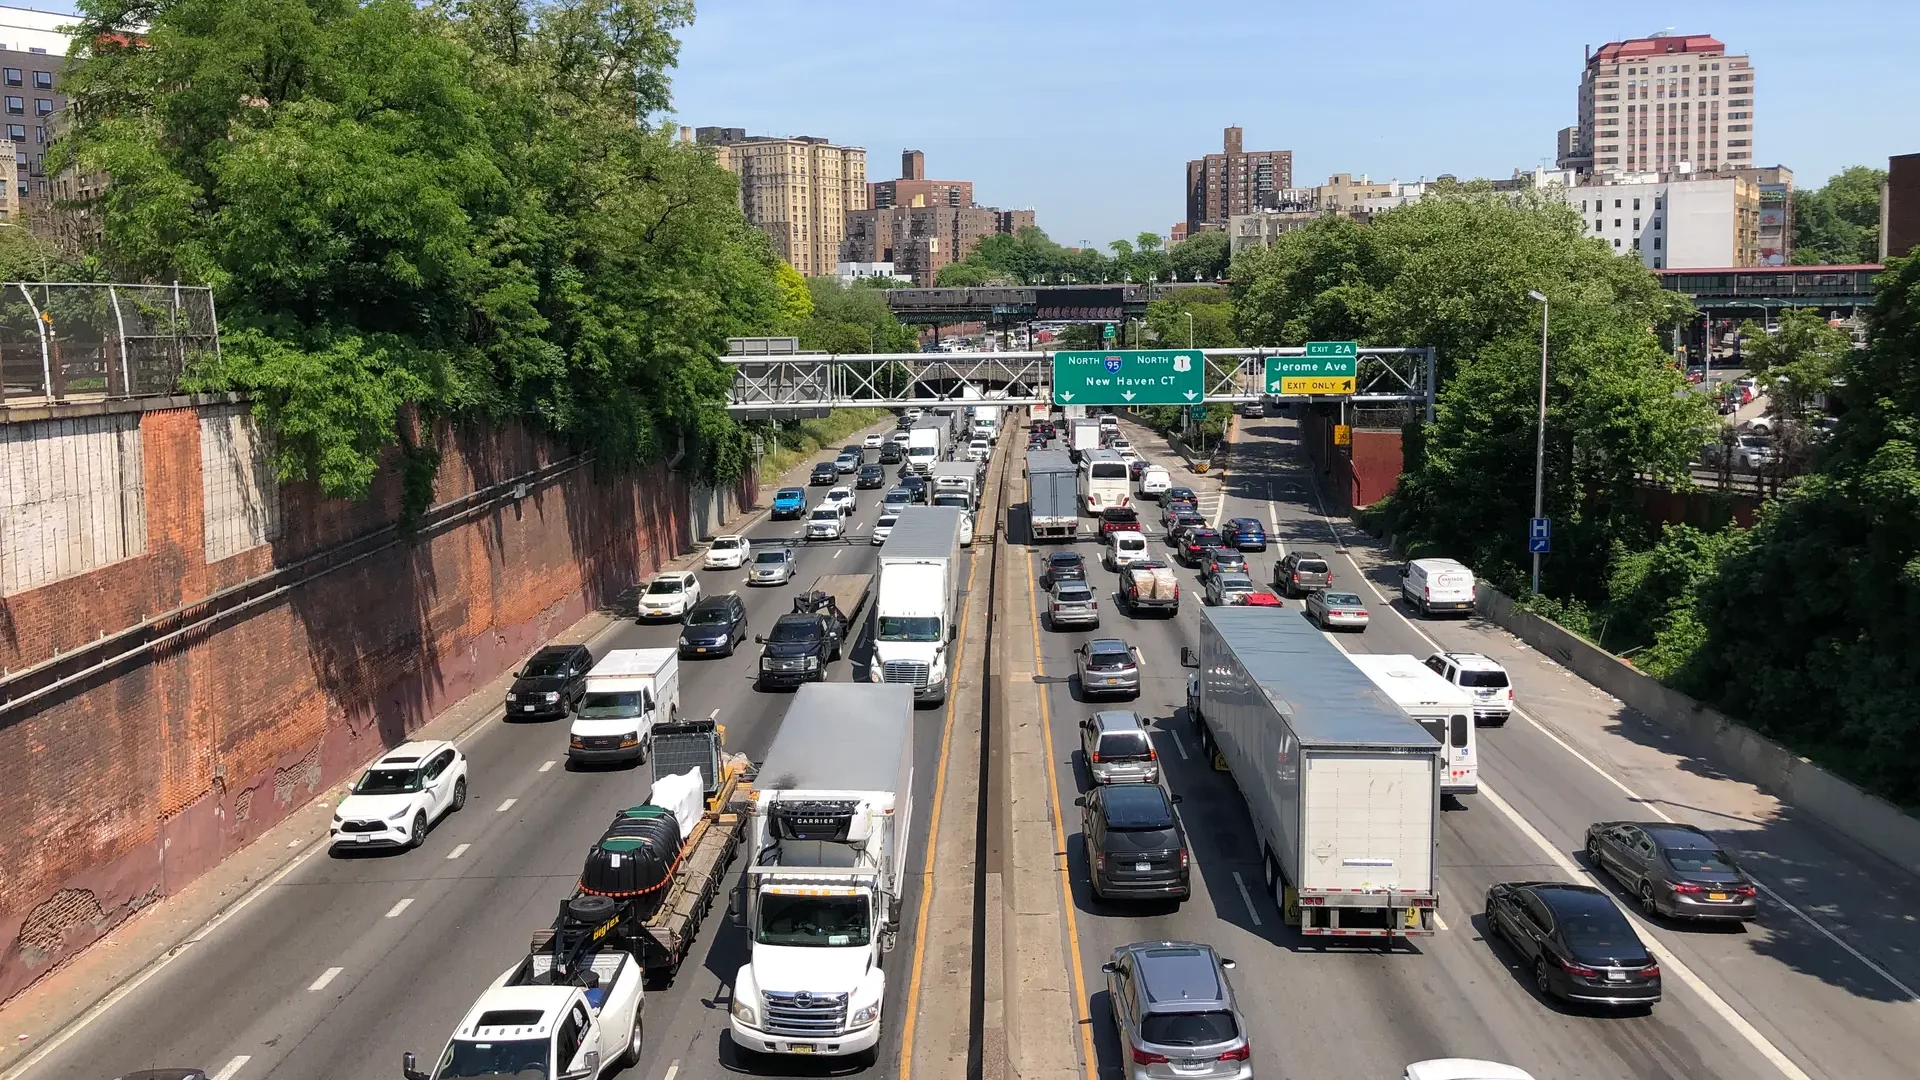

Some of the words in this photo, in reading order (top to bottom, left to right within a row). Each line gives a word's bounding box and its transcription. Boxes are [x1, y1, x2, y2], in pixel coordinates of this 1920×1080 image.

[1334, 345, 1351, 354] 2A
[1068, 356, 1100, 365] NORTH
[1107, 361, 1119, 370] 95
[1137, 355, 1169, 364] NORTH
[1274, 362, 1318, 371] Jerome
[1324, 361, 1347, 371] Ave
[1086, 377, 1110, 386] New
[1117, 376, 1155, 386] Haven
[1161, 376, 1175, 385] CT
[1532, 519, 1548, 537] H
